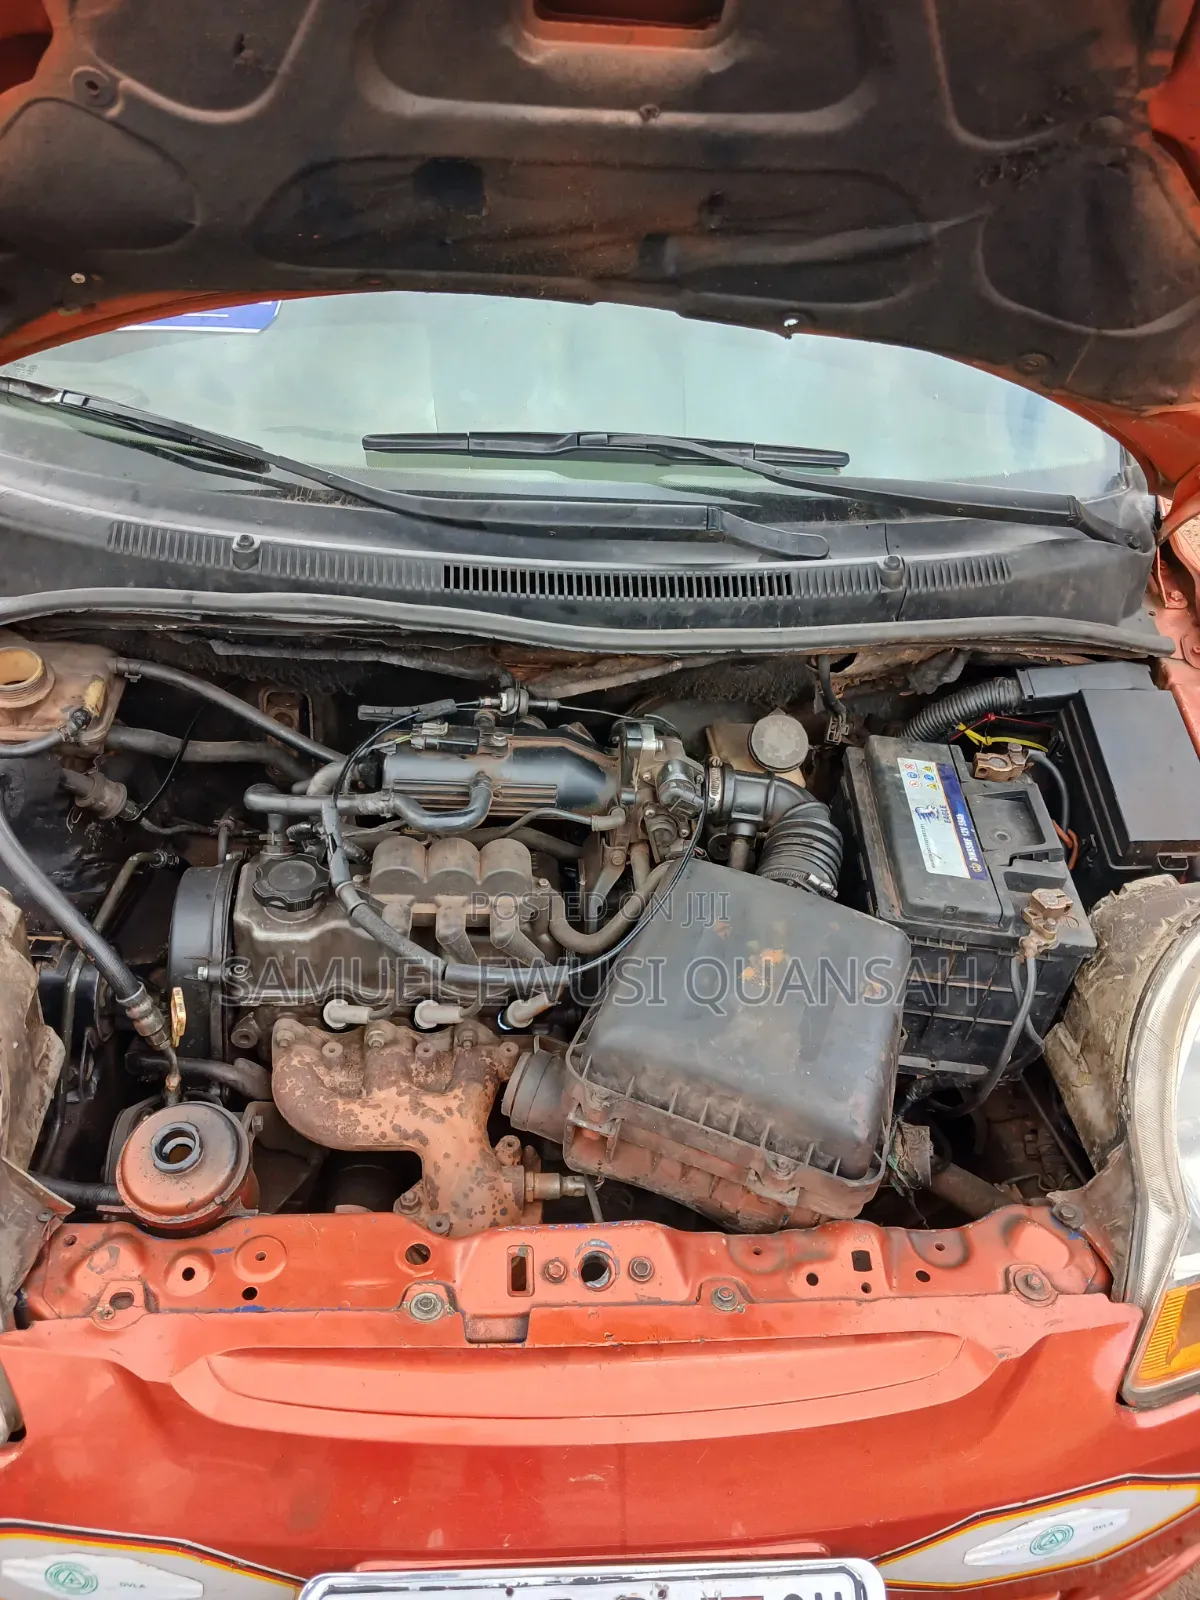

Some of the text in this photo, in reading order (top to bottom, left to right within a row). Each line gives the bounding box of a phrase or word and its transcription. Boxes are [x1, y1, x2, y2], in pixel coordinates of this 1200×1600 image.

[940, 805, 951, 824] EAGLE
[960, 825, 970, 837] 12V
[119, 1581, 146, 1589] DVLA
